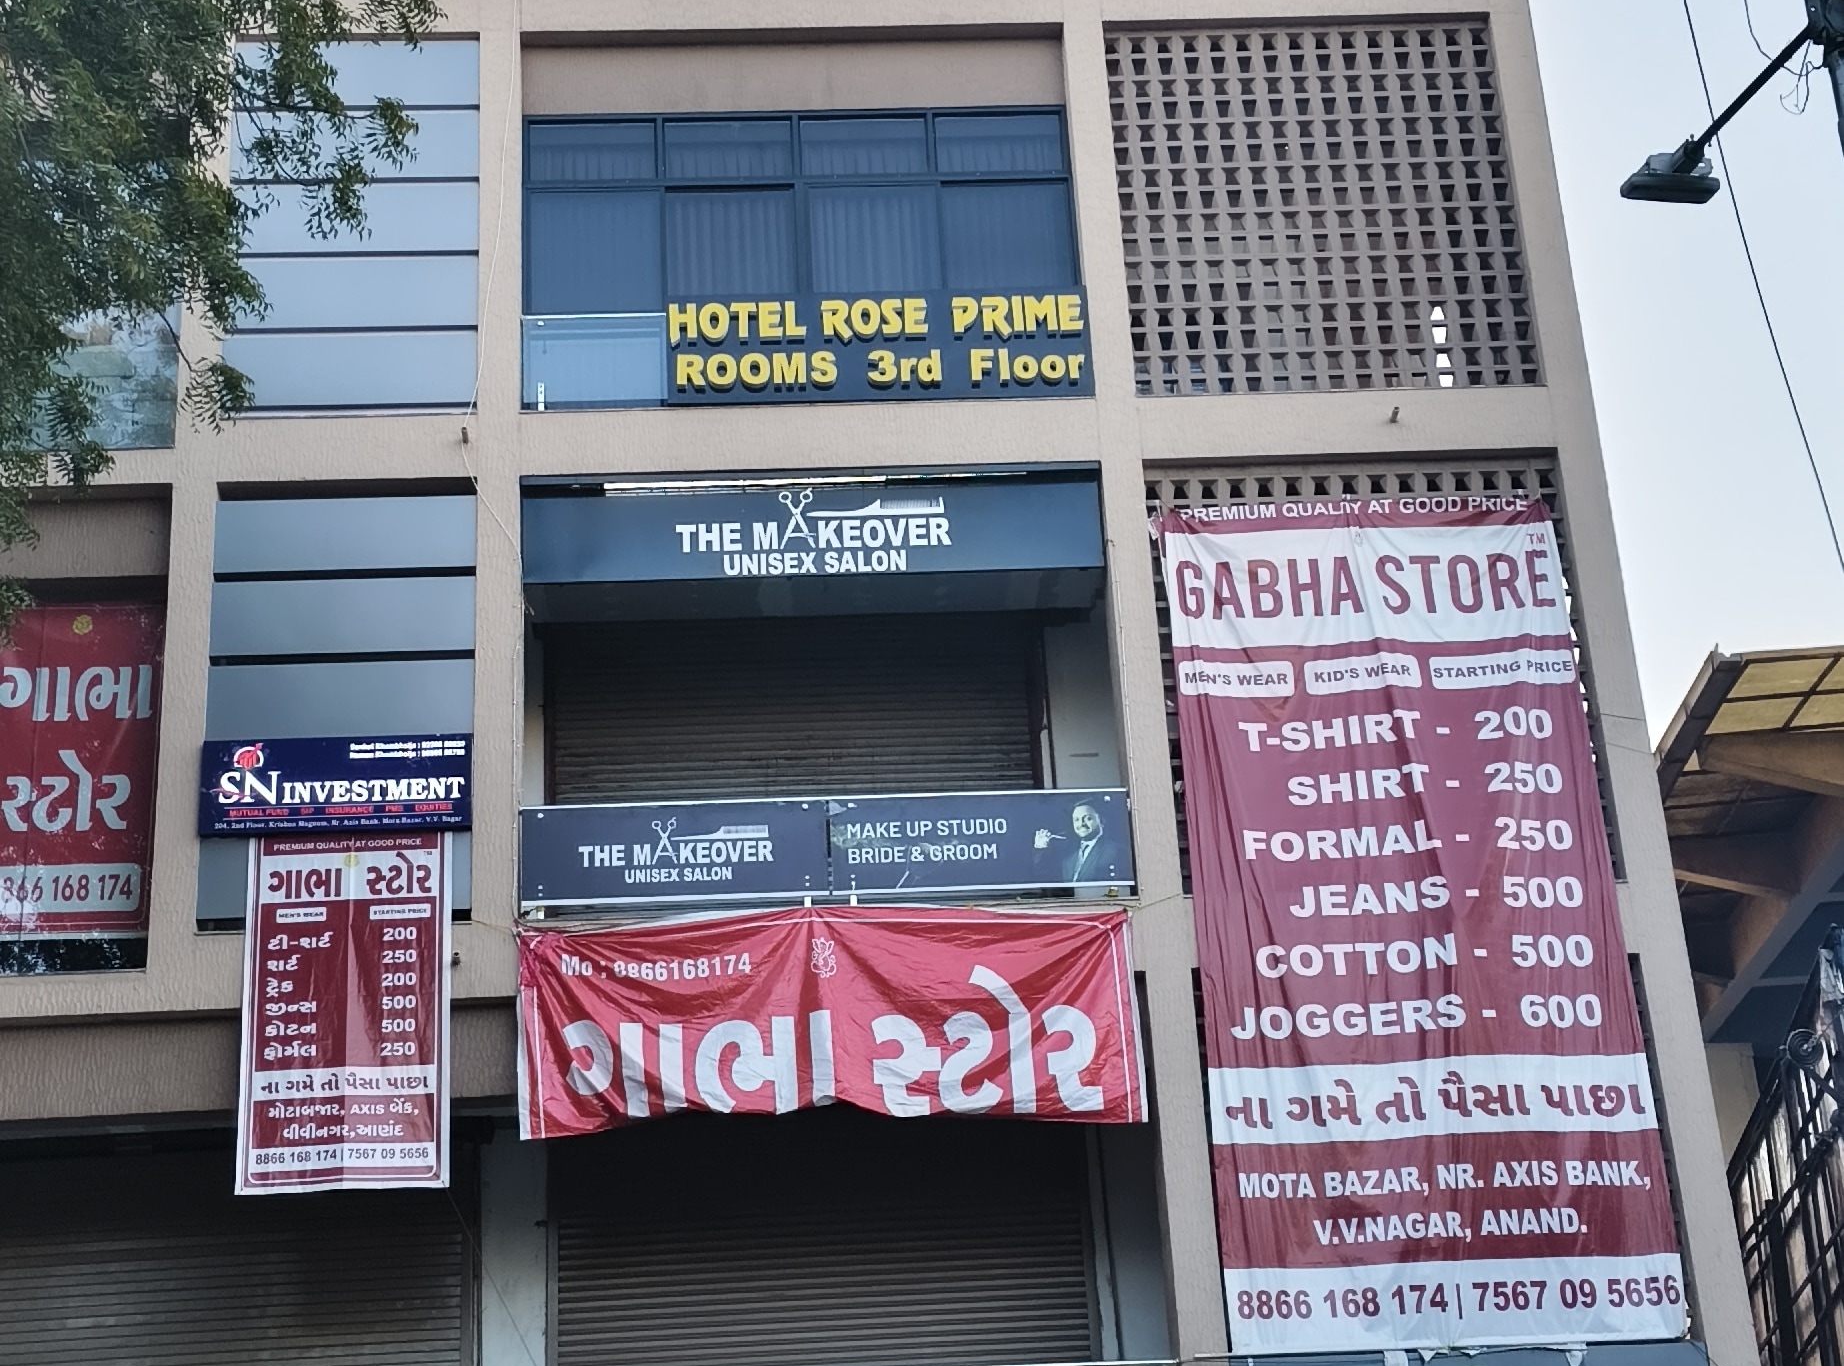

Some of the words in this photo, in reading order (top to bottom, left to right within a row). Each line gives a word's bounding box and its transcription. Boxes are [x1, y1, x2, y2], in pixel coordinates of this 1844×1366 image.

[668, 301, 807, 347] HOTEL
[821, 298, 929, 344] ROSE
[951, 294, 1085, 340] PRIME
[676, 350, 838, 390] ROOMS
[867, 349, 943, 385] 3rd
[970, 348, 1085, 384] Floor
[1182, 503, 1276, 524] PREMIUM
[1368, 498, 1393, 515] AT
[1399, 496, 1461, 514] GOOD
[1467, 496, 1529, 513] PRICE
[676, 523, 743, 553] THE
[753, 503, 952, 551] MAKEOVER
[723, 552, 817, 576] UNISEX
[825, 550, 908, 573] SALON
[1176, 556, 1365, 621] GABHA
[1375, 549, 1557, 615] STORE
[1184, 670, 1232, 686] MEN'S
[1237, 671, 1289, 687] WEAR
[1314, 666, 1360, 684] KID'S
[1364, 662, 1411, 681] WEAR
[1433, 660, 1522, 680] STARTING
[1527, 659, 1574, 675] PRICE
[0, 664, 152, 722] ગાભા
[1238, 709, 1421, 752] T-SHIRT
[1474, 705, 1554, 740] 200
[1, 749, 132, 832] સ્ટોર
[218, 771, 282, 805] SN
[282, 776, 465, 804] INVESTMENT
[1287, 763, 1430, 806] SHIRT
[1484, 761, 1563, 795] 250
[367, 839, 394, 847] GOOD
[396, 838, 422, 846] PRICE
[846, 820, 903, 840] MAKE
[905, 819, 934, 838] UP
[937, 817, 1007, 837] STUDIO
[1243, 819, 1443, 862] FORMAL
[1494, 816, 1573, 851] 250
[578, 844, 626, 867] THE
[632, 833, 774, 865] MAKEOVER
[847, 844, 907, 864] BRIDE
[910, 845, 926, 862] &
[929, 842, 998, 862] GROOM
[52, 874, 90, 902] 168
[97, 873, 133, 901] 174
[267, 868, 343, 900] ગાભા
[366, 851, 433, 896] સ્ટોર
[624, 867, 680, 884] UNISEX
[683, 866, 733, 882] SALON
[1289, 876, 1451, 918] JEANS
[1503, 875, 1584, 909] 500
[382, 926, 417, 941] 200
[267, 954, 301, 972] શર્ટ
[382, 949, 417, 964] 250
[561, 952, 593, 977] Mo
[1255, 932, 1458, 979] COTTON
[1511, 934, 1594, 968] 500
[381, 972, 416, 988] 200
[381, 995, 417, 1010] 500
[1230, 993, 1467, 1040] JOGGERS
[1519, 992, 1603, 1029] 600
[264, 1020, 317, 1037] કોટન
[381, 1018, 416, 1033] 500
[562, 1009, 836, 1121] ગાભા
[871, 964, 1105, 1118] સ્ટોર
[380, 1042, 416, 1056] 250
[260, 1081, 280, 1094] ના
[285, 1075, 315, 1092] ગમે
[320, 1073, 341, 1091] તો
[345, 1072, 381, 1090] પૈસા
[386, 1075, 429, 1089] પાછા
[350, 1104, 385, 1115] AXIS
[1225, 1095, 1274, 1130] ના
[1285, 1078, 1362, 1128] ગમે
[1374, 1076, 1428, 1124] તો
[1437, 1070, 1531, 1118] પૈસા
[1540, 1083, 1646, 1119] પાછા
[255, 1152, 286, 1165] 8866
[289, 1151, 312, 1163] 168
[315, 1149, 338, 1162] 174
[347, 1148, 377, 1161] 7567
[380, 1148, 396, 1160] 09
[399, 1146, 430, 1159] 5656
[1238, 1172, 1317, 1199] MOTA
[1323, 1166, 1430, 1198] BAZAR,
[1436, 1162, 1484, 1190] NR.
[1493, 1160, 1559, 1188] AXIS
[1565, 1160, 1652, 1192] BANK,
[1312, 1211, 1473, 1246] V.V.NAGAR,
[1480, 1206, 1589, 1236] ANAND.
[1237, 1289, 1314, 1320] 8866
[1323, 1287, 1381, 1318] 168
[1391, 1282, 1449, 1315] 174
[1471, 1280, 1549, 1312] 7567
[1558, 1278, 1598, 1309] 09
[1606, 1275, 1682, 1308] 5656
